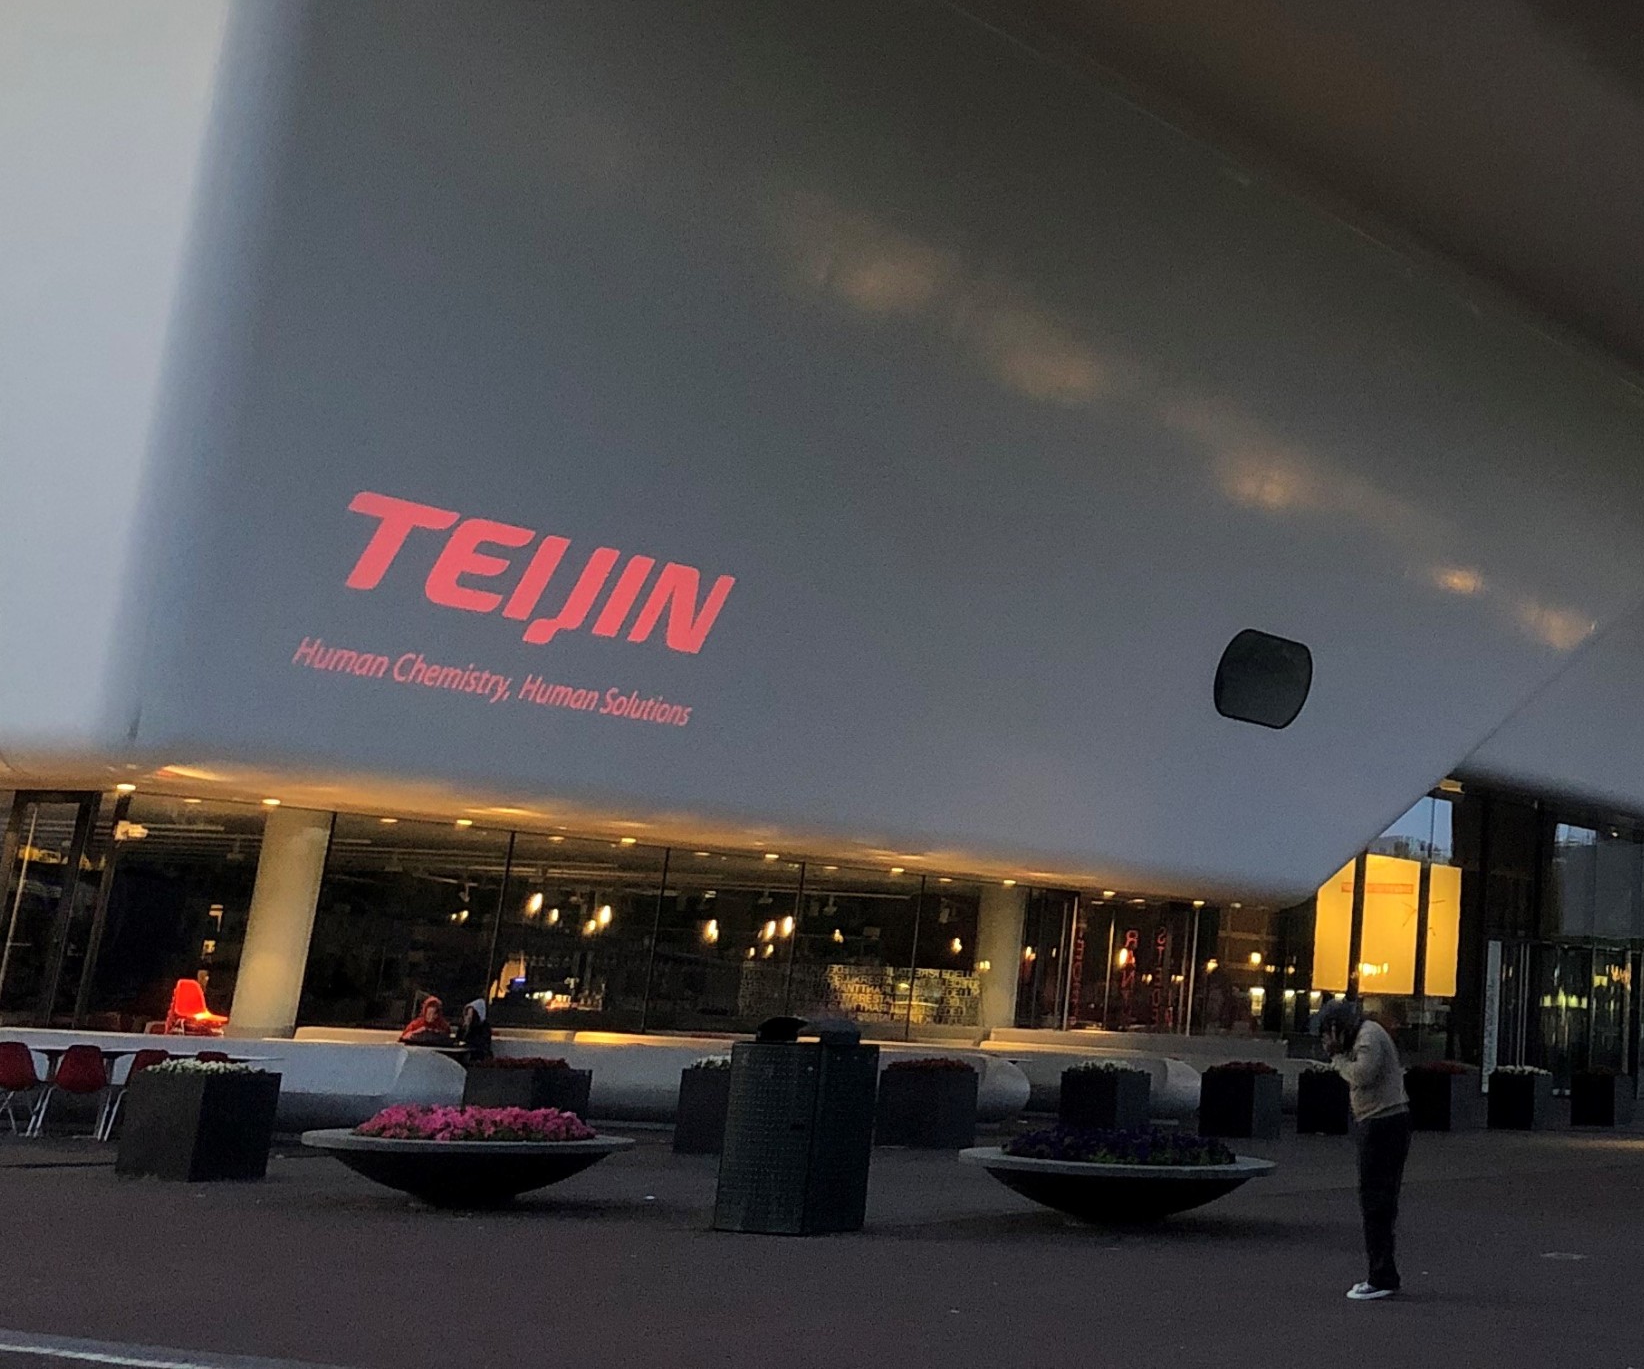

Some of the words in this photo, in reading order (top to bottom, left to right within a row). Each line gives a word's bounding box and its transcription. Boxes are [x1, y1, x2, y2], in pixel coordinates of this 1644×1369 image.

[345, 490, 736, 654] TEIJIN
[291, 636, 390, 679] Human
[393, 652, 512, 704] Chemistry,
[518, 673, 600, 712] Human
[600, 686, 693, 727] Solutions
